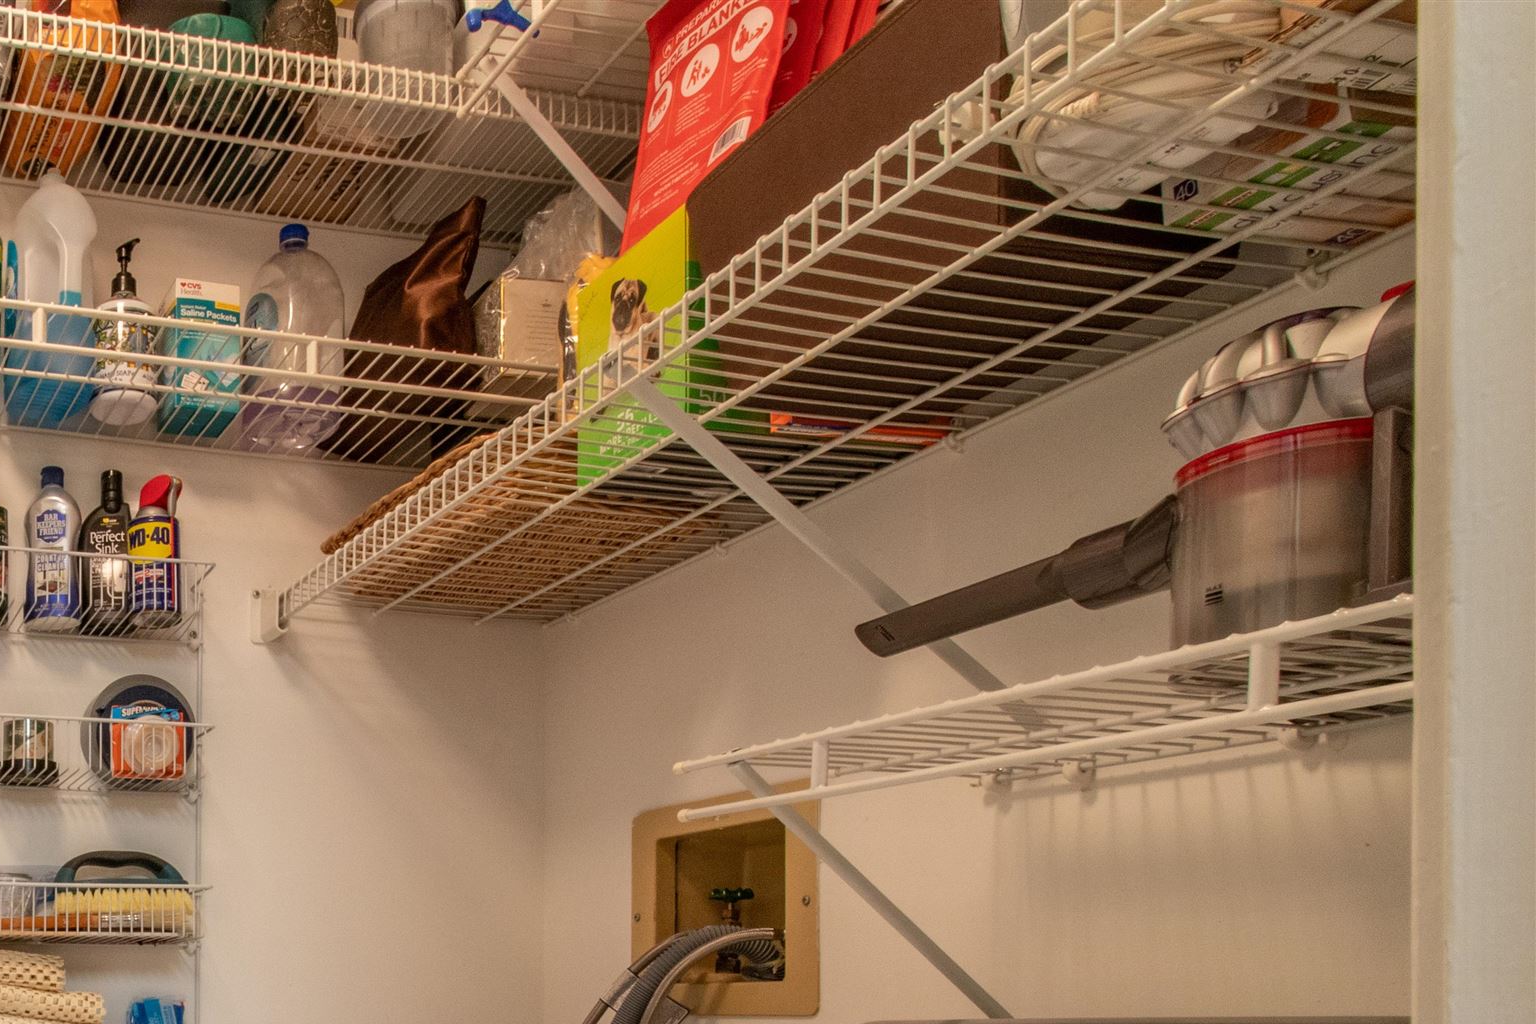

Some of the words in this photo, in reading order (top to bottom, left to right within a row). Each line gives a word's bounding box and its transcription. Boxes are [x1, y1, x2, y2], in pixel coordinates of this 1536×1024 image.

[186, 281, 202, 290] CVS
[180, 308, 205, 319] Saline
[206, 311, 237, 323] Packets
[43, 513, 59, 521] BAR
[37, 519, 66, 528] KEEPERS
[39, 526, 64, 536] FRIEND
[89, 529, 126, 545] Perfect
[129, 526, 170, 551] WD-40
[95, 543, 120, 555] Sink
